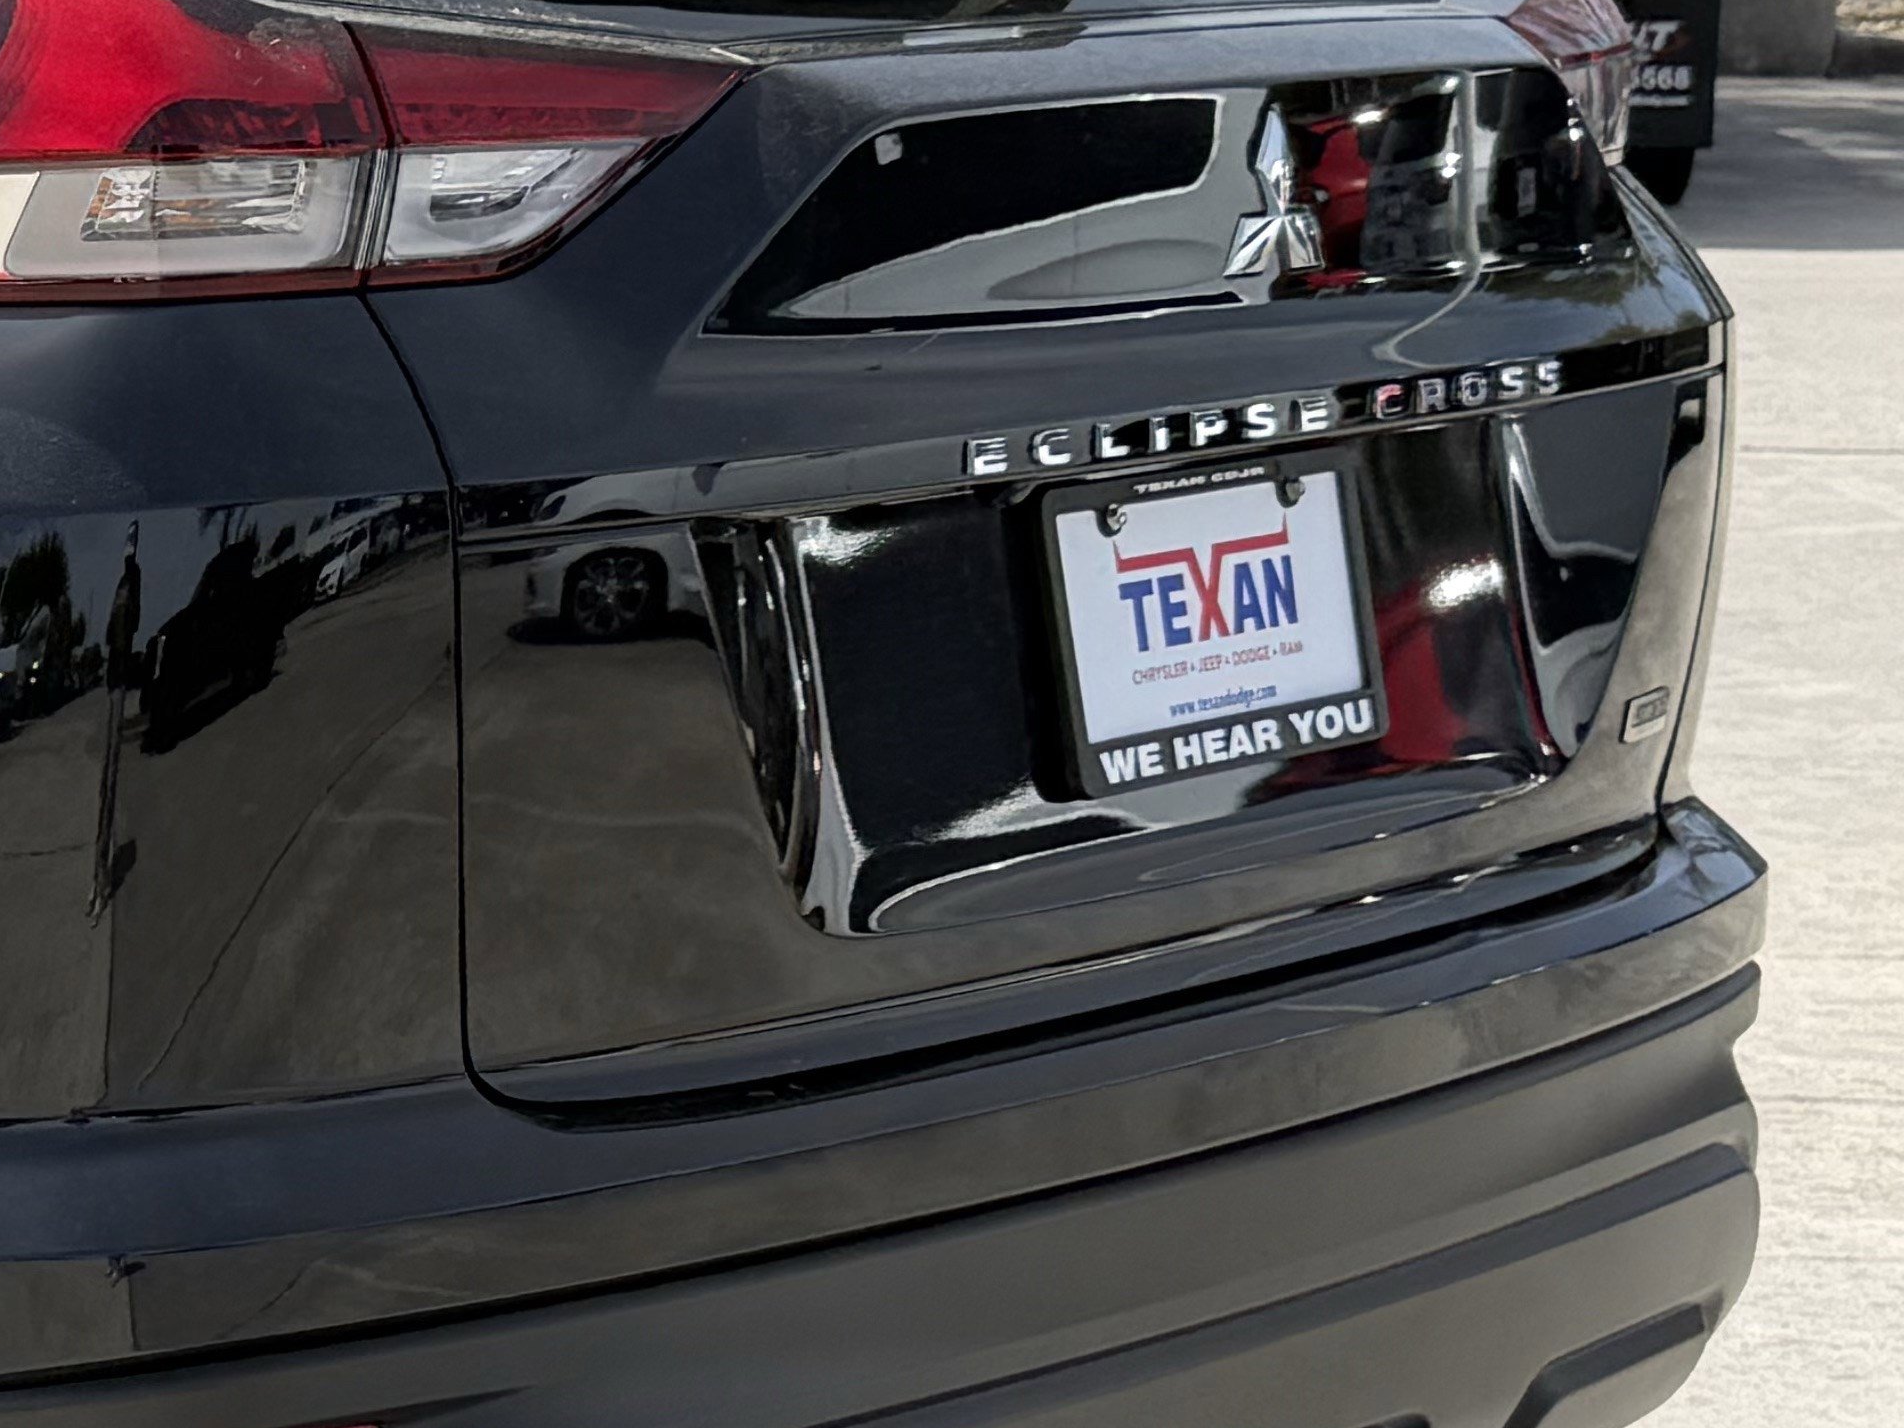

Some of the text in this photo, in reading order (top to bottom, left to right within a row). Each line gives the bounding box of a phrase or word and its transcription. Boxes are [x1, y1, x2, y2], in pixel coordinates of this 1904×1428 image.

[966, 361, 1562, 476] ECLIPSE CROSS
[1133, 474, 1206, 494] TEXAN
[1116, 534, 1299, 653] TEXAN
[1132, 641, 1303, 685] CHRYSLER JEEP DODGE RAM
[1099, 698, 1374, 784] WE HEAR YOU
